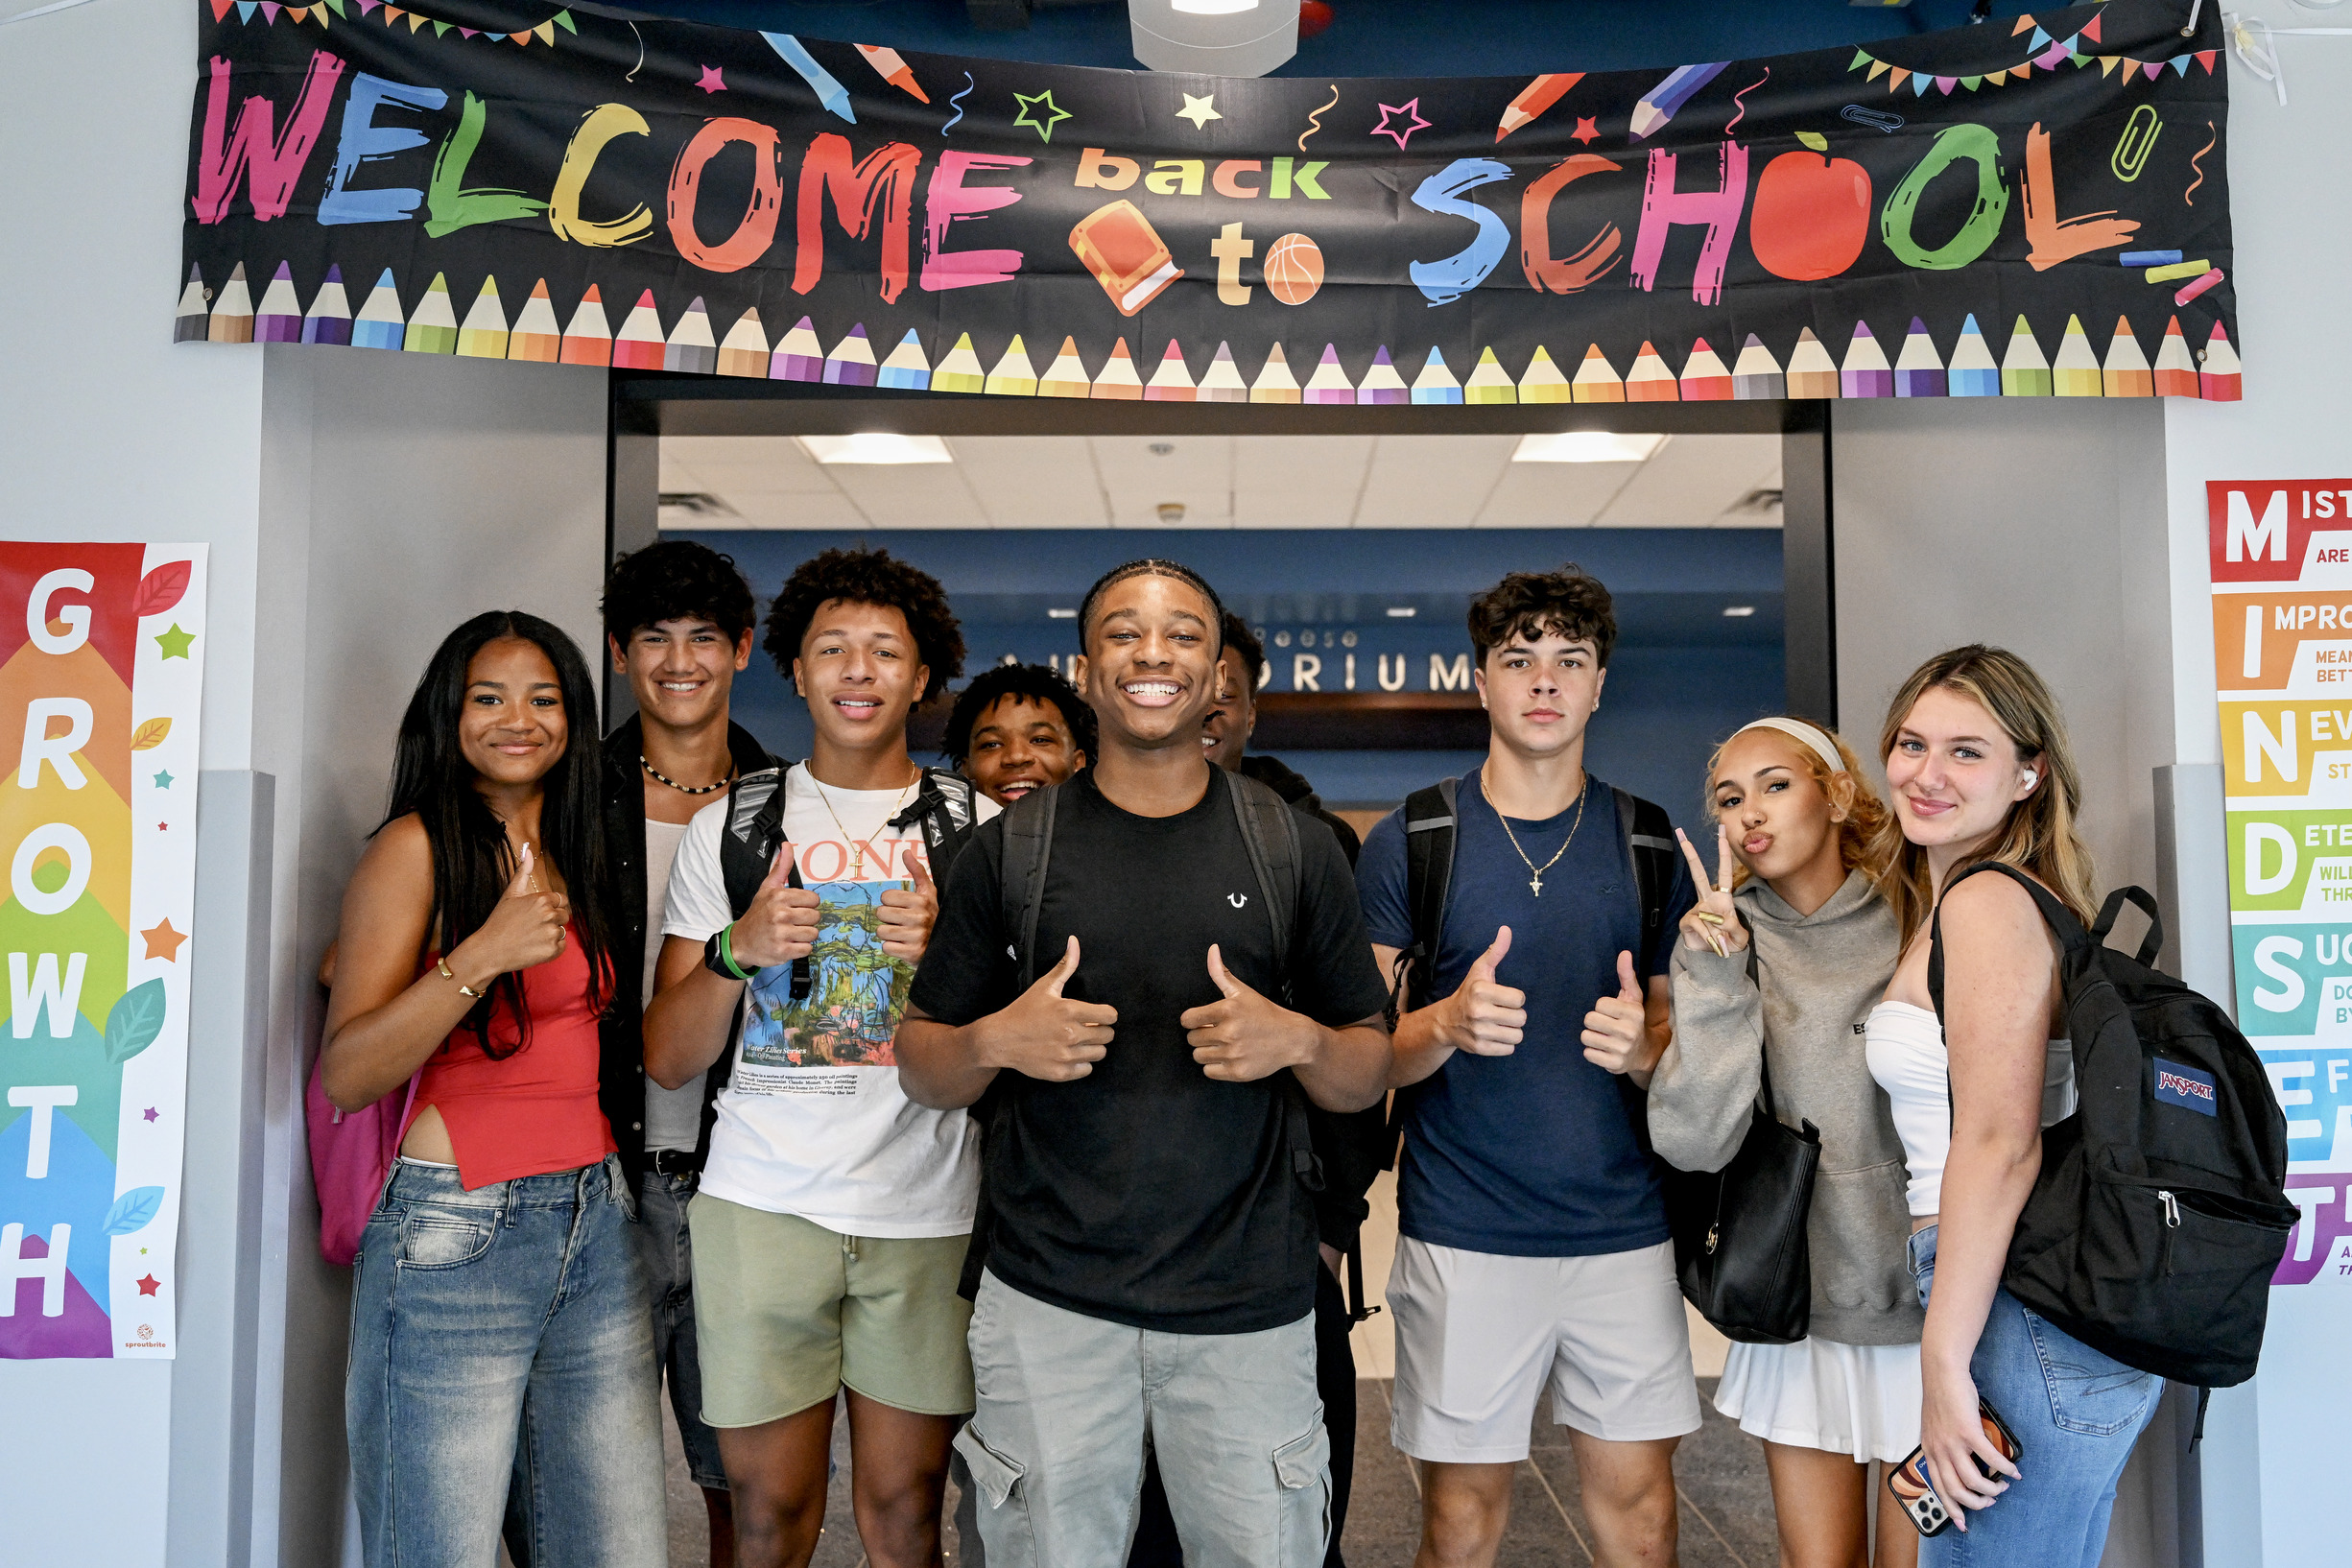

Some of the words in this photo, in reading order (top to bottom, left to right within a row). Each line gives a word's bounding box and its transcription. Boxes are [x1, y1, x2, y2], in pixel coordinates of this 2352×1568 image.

[190, 48, 1033, 304] WELCOME
[1074, 147, 1332, 200] back
[1409, 121, 2141, 308] SCHOOL
[1211, 222, 1324, 306] to
[2316, 548, 2349, 563] ARE
[2316, 651, 2352, 664] MEA
[0, 568, 95, 1318] GROWTH
[2159, 1071, 2213, 1101] JANSPORT
